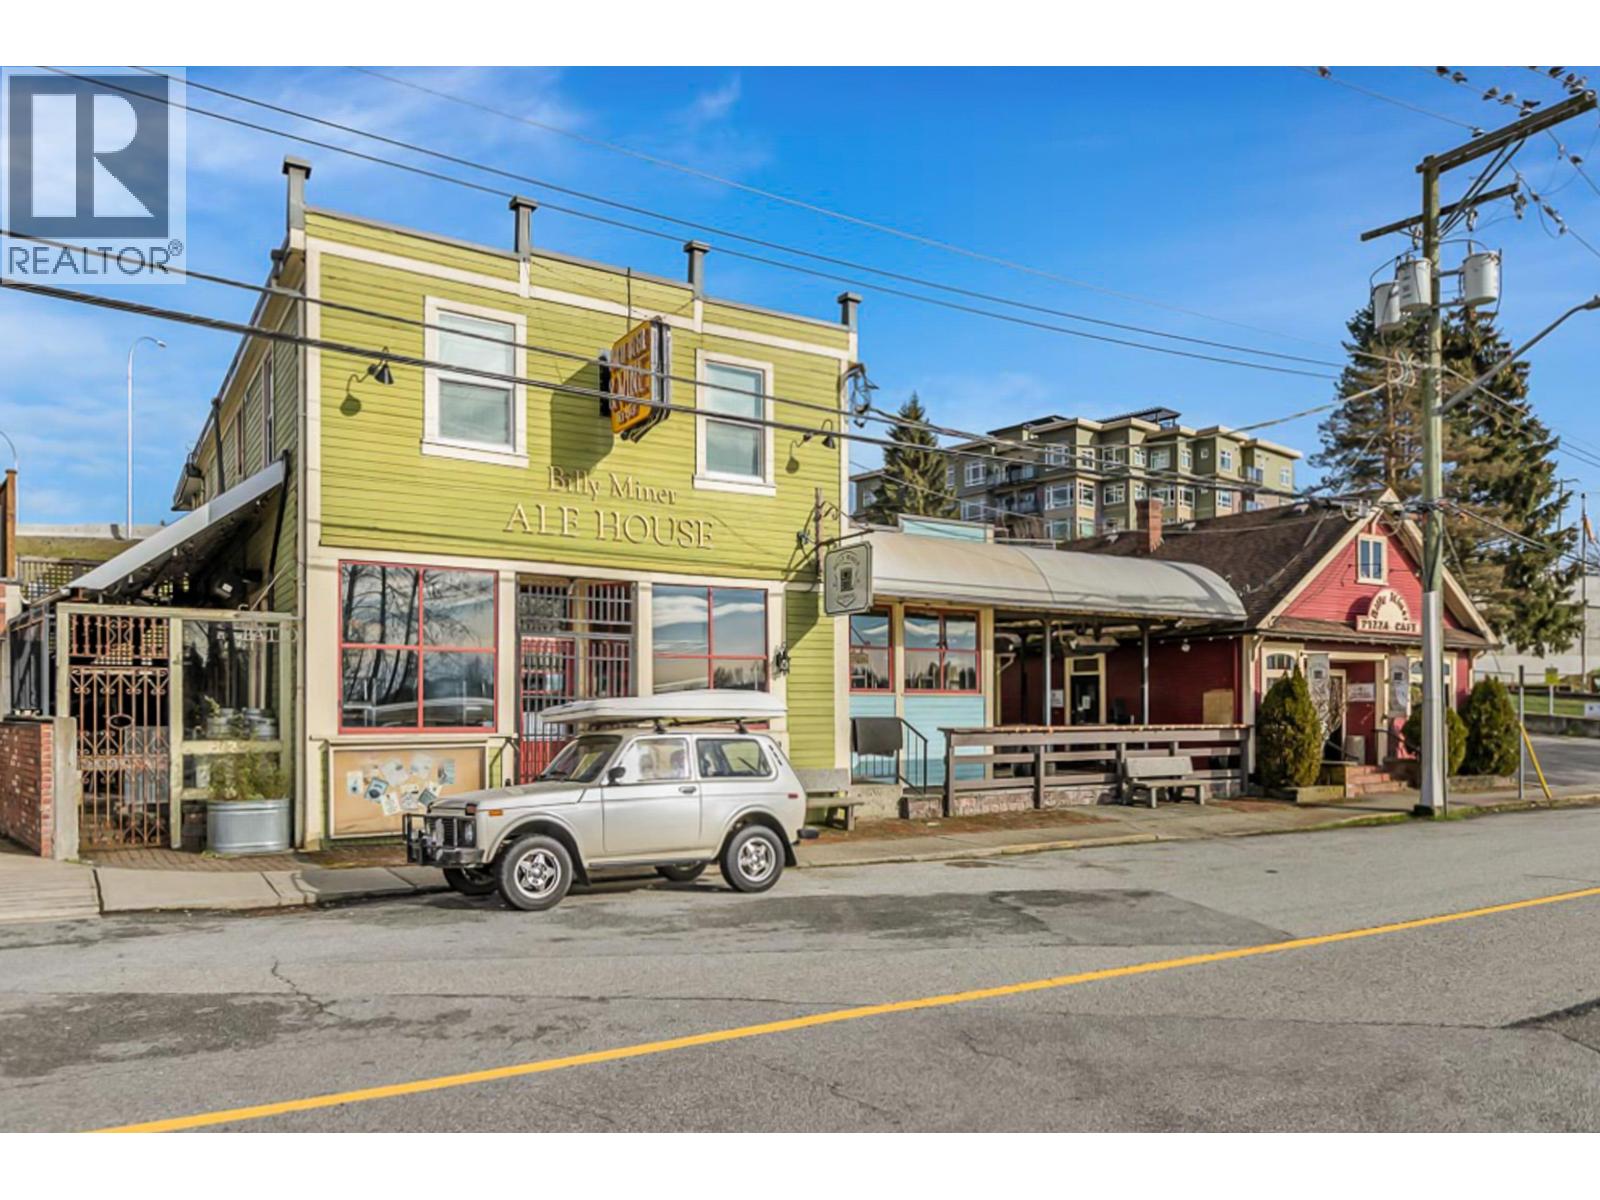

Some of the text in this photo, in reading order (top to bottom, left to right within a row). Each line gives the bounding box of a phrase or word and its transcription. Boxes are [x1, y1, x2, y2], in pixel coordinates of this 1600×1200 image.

[548, 466, 678, 505] Billy Miner
[503, 503, 715, 549] ALE HOUSE
[1361, 620, 1389, 630] PIZZA
